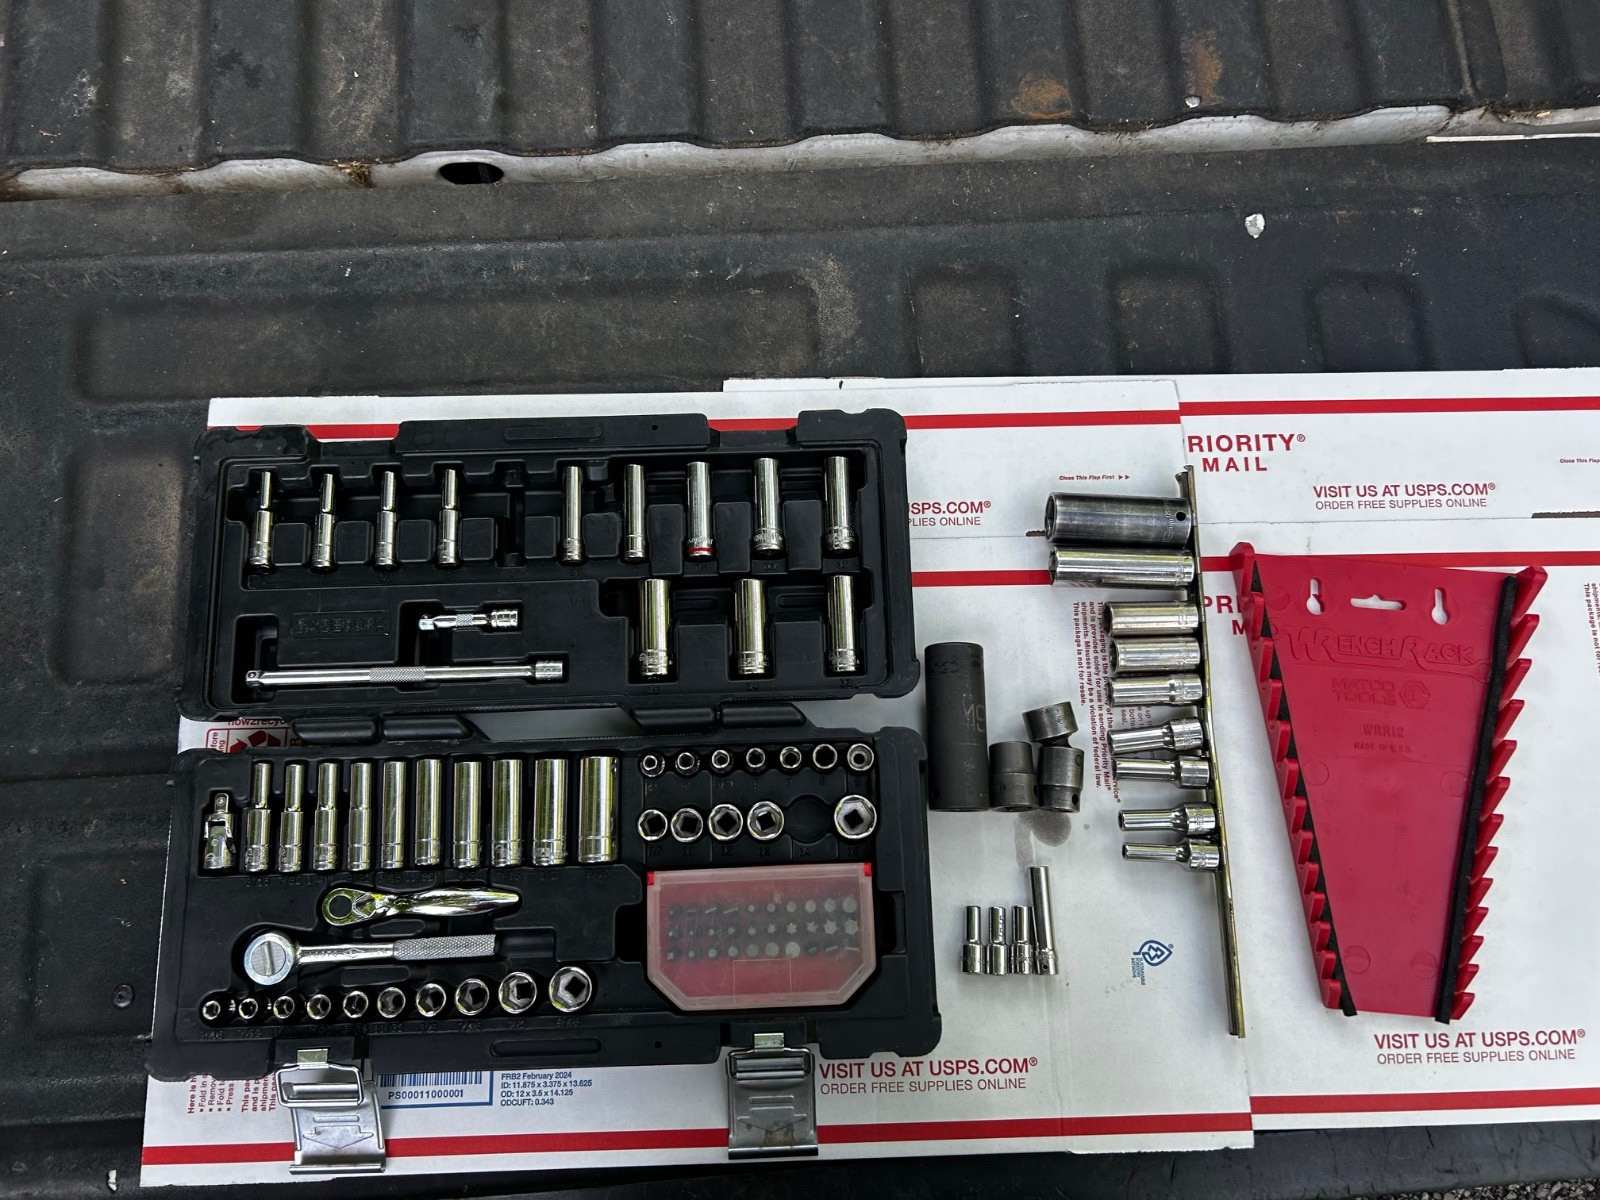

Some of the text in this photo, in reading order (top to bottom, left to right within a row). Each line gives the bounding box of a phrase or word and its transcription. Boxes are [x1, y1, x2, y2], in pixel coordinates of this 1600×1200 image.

[1187, 432, 1306, 453] RIORITY®
[1202, 456, 1268, 473] MAIL
[1313, 485, 1351, 498] VISIT
[1356, 485, 1378, 497] US
[1381, 484, 1400, 497] AT
[1315, 498, 1487, 510] ORDER FREE SUPPLIES ONLINE
[939, 516, 981, 526] ONLINE
[1585, 599, 1595, 628] package
[1073, 618, 1081, 647] package
[1090, 624, 1099, 654] provided
[1088, 688, 1094, 696] be
[1089, 705, 1098, 735] violation
[1106, 708, 1113, 716] of
[1098, 713, 1106, 741] sending
[1093, 746, 1101, 772] federal
[1101, 743, 1109, 769] Priority
[1374, 1033, 1419, 1049] VISIT
[1425, 1033, 1449, 1048] US
[1455, 1032, 1476, 1047] AT
[1377, 1048, 1576, 1065] ORDER FREE SUPPLIES ONLINE
[522, 1072, 553, 1081] February
[819, 1062, 865, 1079] VISIT
[871, 1061, 896, 1078] US
[901, 1060, 924, 1077] AT
[199, 1080, 207, 1088] in
[543, 1080, 561, 1088] 3.375
[820, 1077, 1026, 1095] ORDER FREE SUPPLIES ONLINE
[199, 1090, 207, 1107] Fold
[217, 1088, 225, 1105] Fold
[226, 1083, 234, 1105] Press
[388, 1089, 464, 1100] PS00011000001
[187, 1094, 195, 1114] Here
[241, 1095, 249, 1112] This
